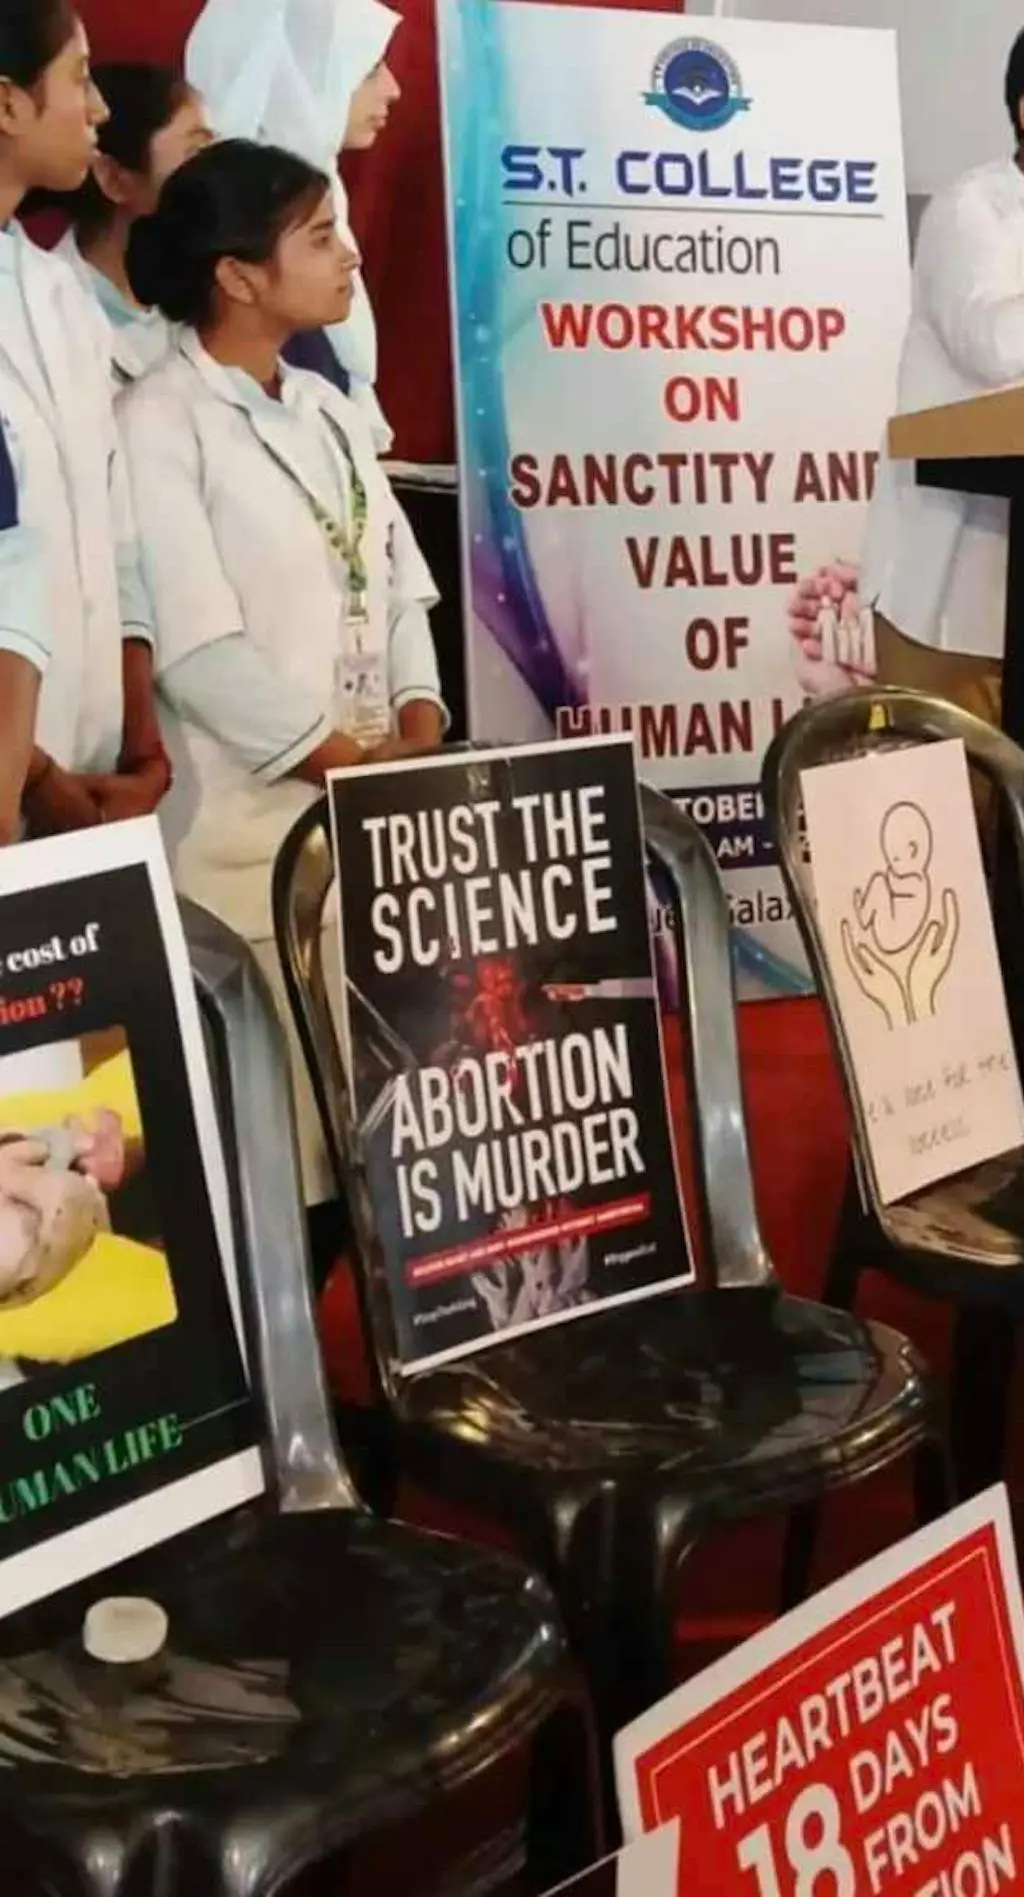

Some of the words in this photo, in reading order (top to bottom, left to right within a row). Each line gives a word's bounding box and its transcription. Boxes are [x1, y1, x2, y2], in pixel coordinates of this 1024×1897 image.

[501, 145, 587, 197] S.T.
[615, 149, 878, 203] COLLEGE
[507, 219, 552, 269] of
[567, 220, 781, 275] Education
[541, 303, 846, 351] WORKSHOP
[664, 376, 741, 422] ON
[510, 451, 776, 508] SANCTITY
[625, 533, 797, 589] VALUE
[685, 616, 751, 670] OF
[361, 799, 501, 889] TRUST
[511, 785, 612, 863] THE
[717, 836, 755, 858] AM
[370, 855, 619, 975] SCIENCE
[6, 935, 68, 974] cost
[69, 921, 101, 957] of
[391, 1023, 634, 1158] ABORTION
[396, 1158, 442, 1239] IS
[451, 1107, 647, 1222] MURDER
[22, 1382, 101, 1441] ONE
[0, 1446, 101, 1524] UMAN
[102, 1413, 184, 1475] LIFE
[707, 1600, 958, 1831] HEARTBEAT
[736, 1782, 857, 1897] 18
[848, 1692, 960, 1815] DAYS
[862, 1760, 983, 1895] FROM
